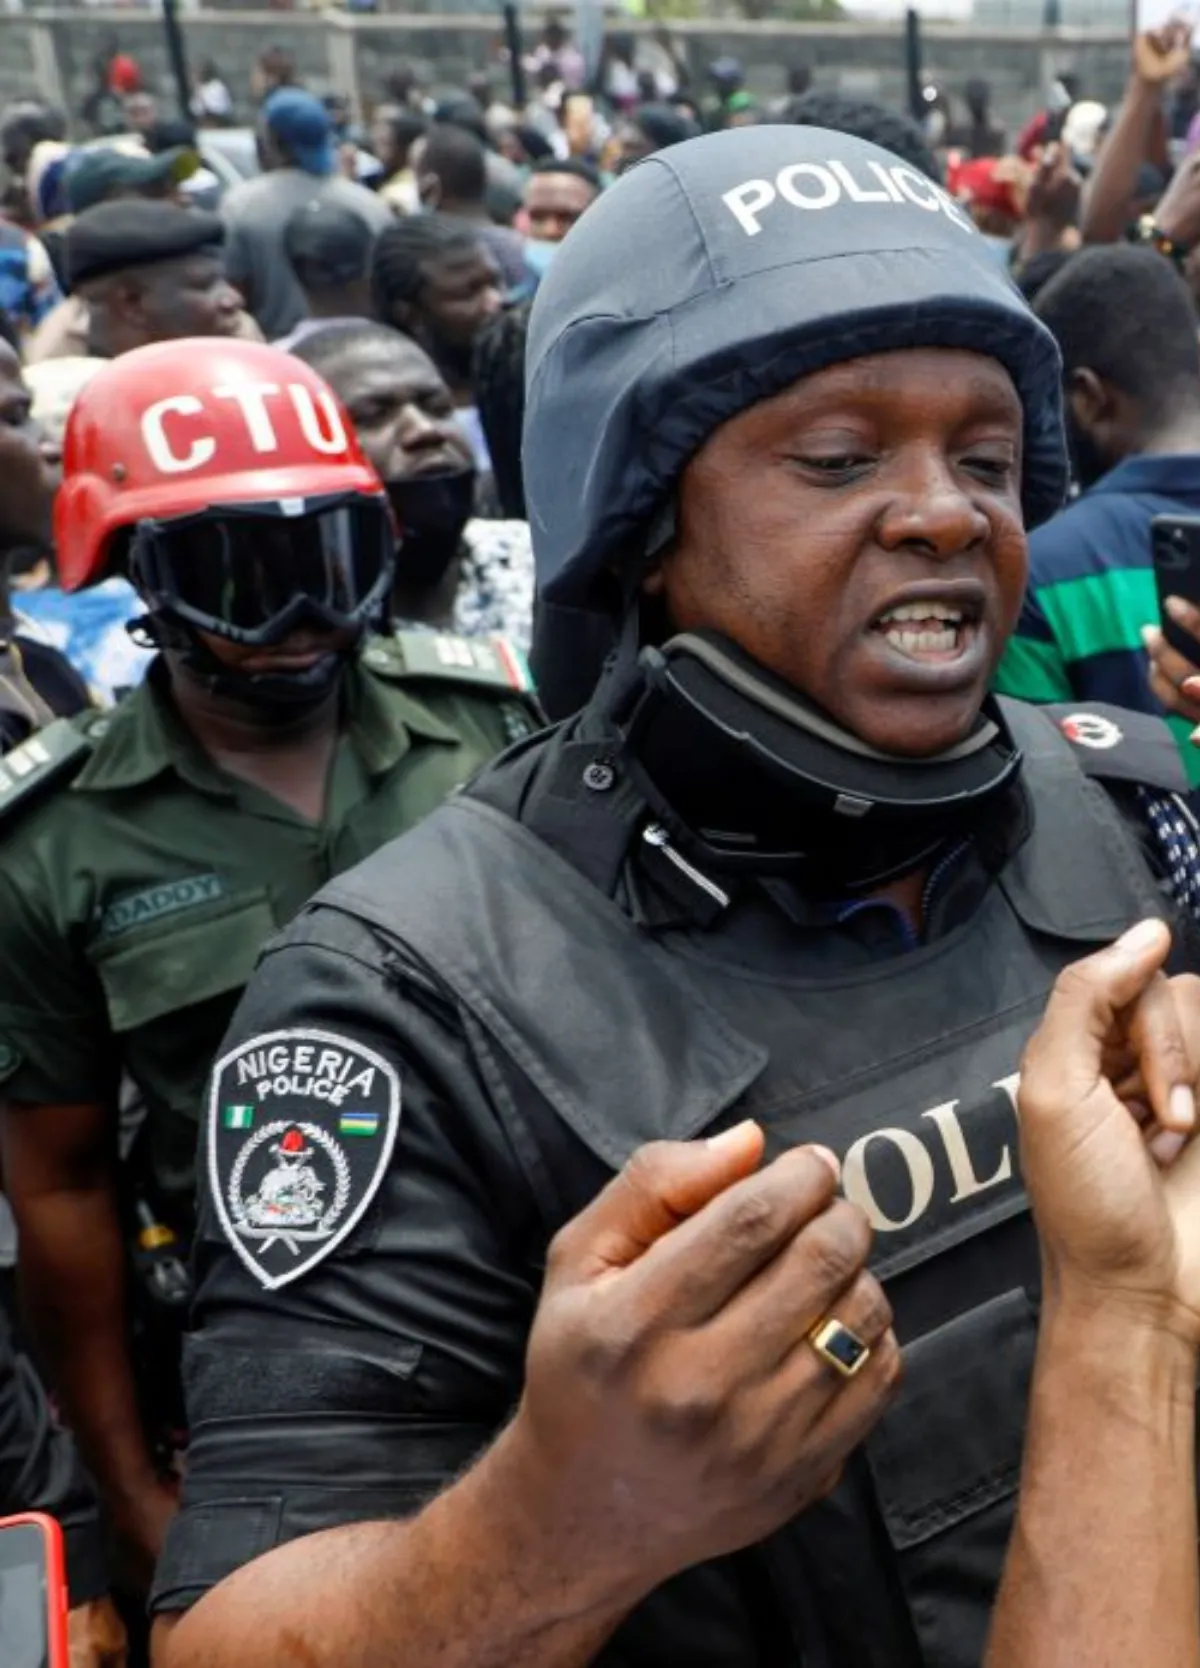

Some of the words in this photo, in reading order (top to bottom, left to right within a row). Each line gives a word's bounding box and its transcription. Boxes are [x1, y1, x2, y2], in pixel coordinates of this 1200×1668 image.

[141, 382, 348, 473] CTU
[236, 1045, 376, 1098] NIGERIA
[255, 1075, 351, 1106] POLICE
[842, 1071, 1022, 1232] OL
